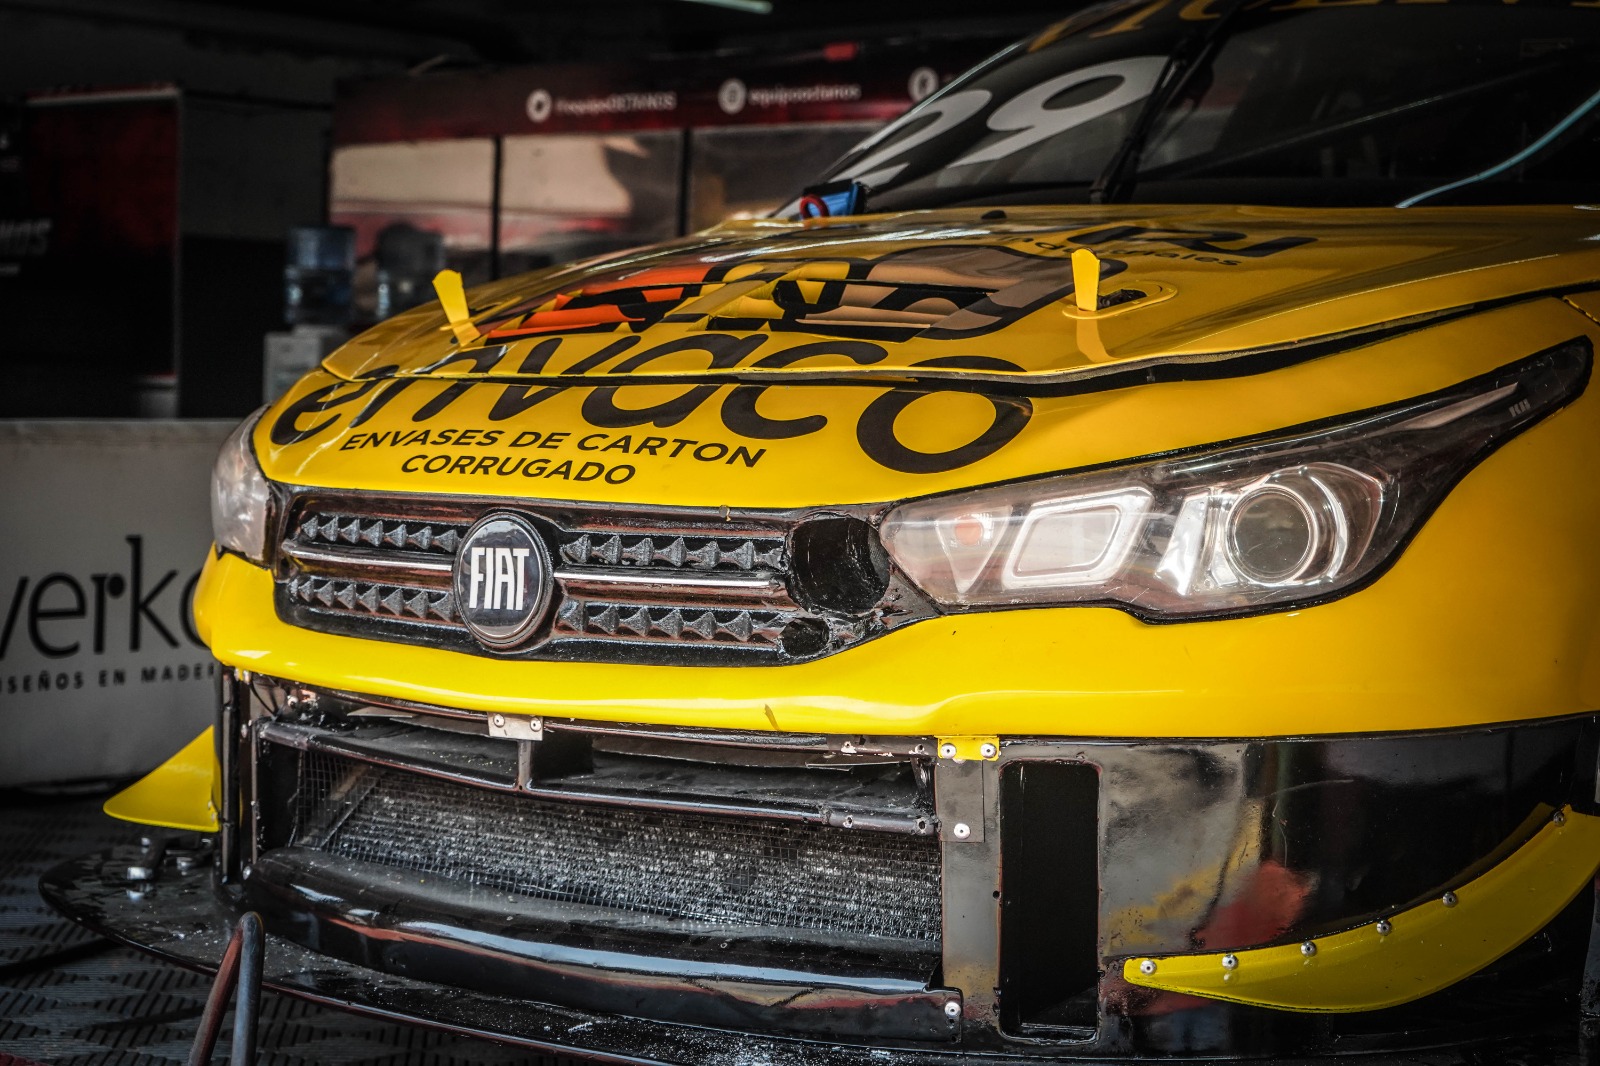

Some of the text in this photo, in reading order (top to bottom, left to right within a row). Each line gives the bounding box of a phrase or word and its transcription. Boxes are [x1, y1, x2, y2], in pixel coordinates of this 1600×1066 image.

[828, 56, 1171, 188] 29
[270, 334, 1034, 475] envaco
[340, 429, 766, 468] ENVASES DE CARTON
[401, 454, 636, 484] CORRUGADO
[469, 547, 530, 610] FIAT
[98, 669, 126, 687] EN
